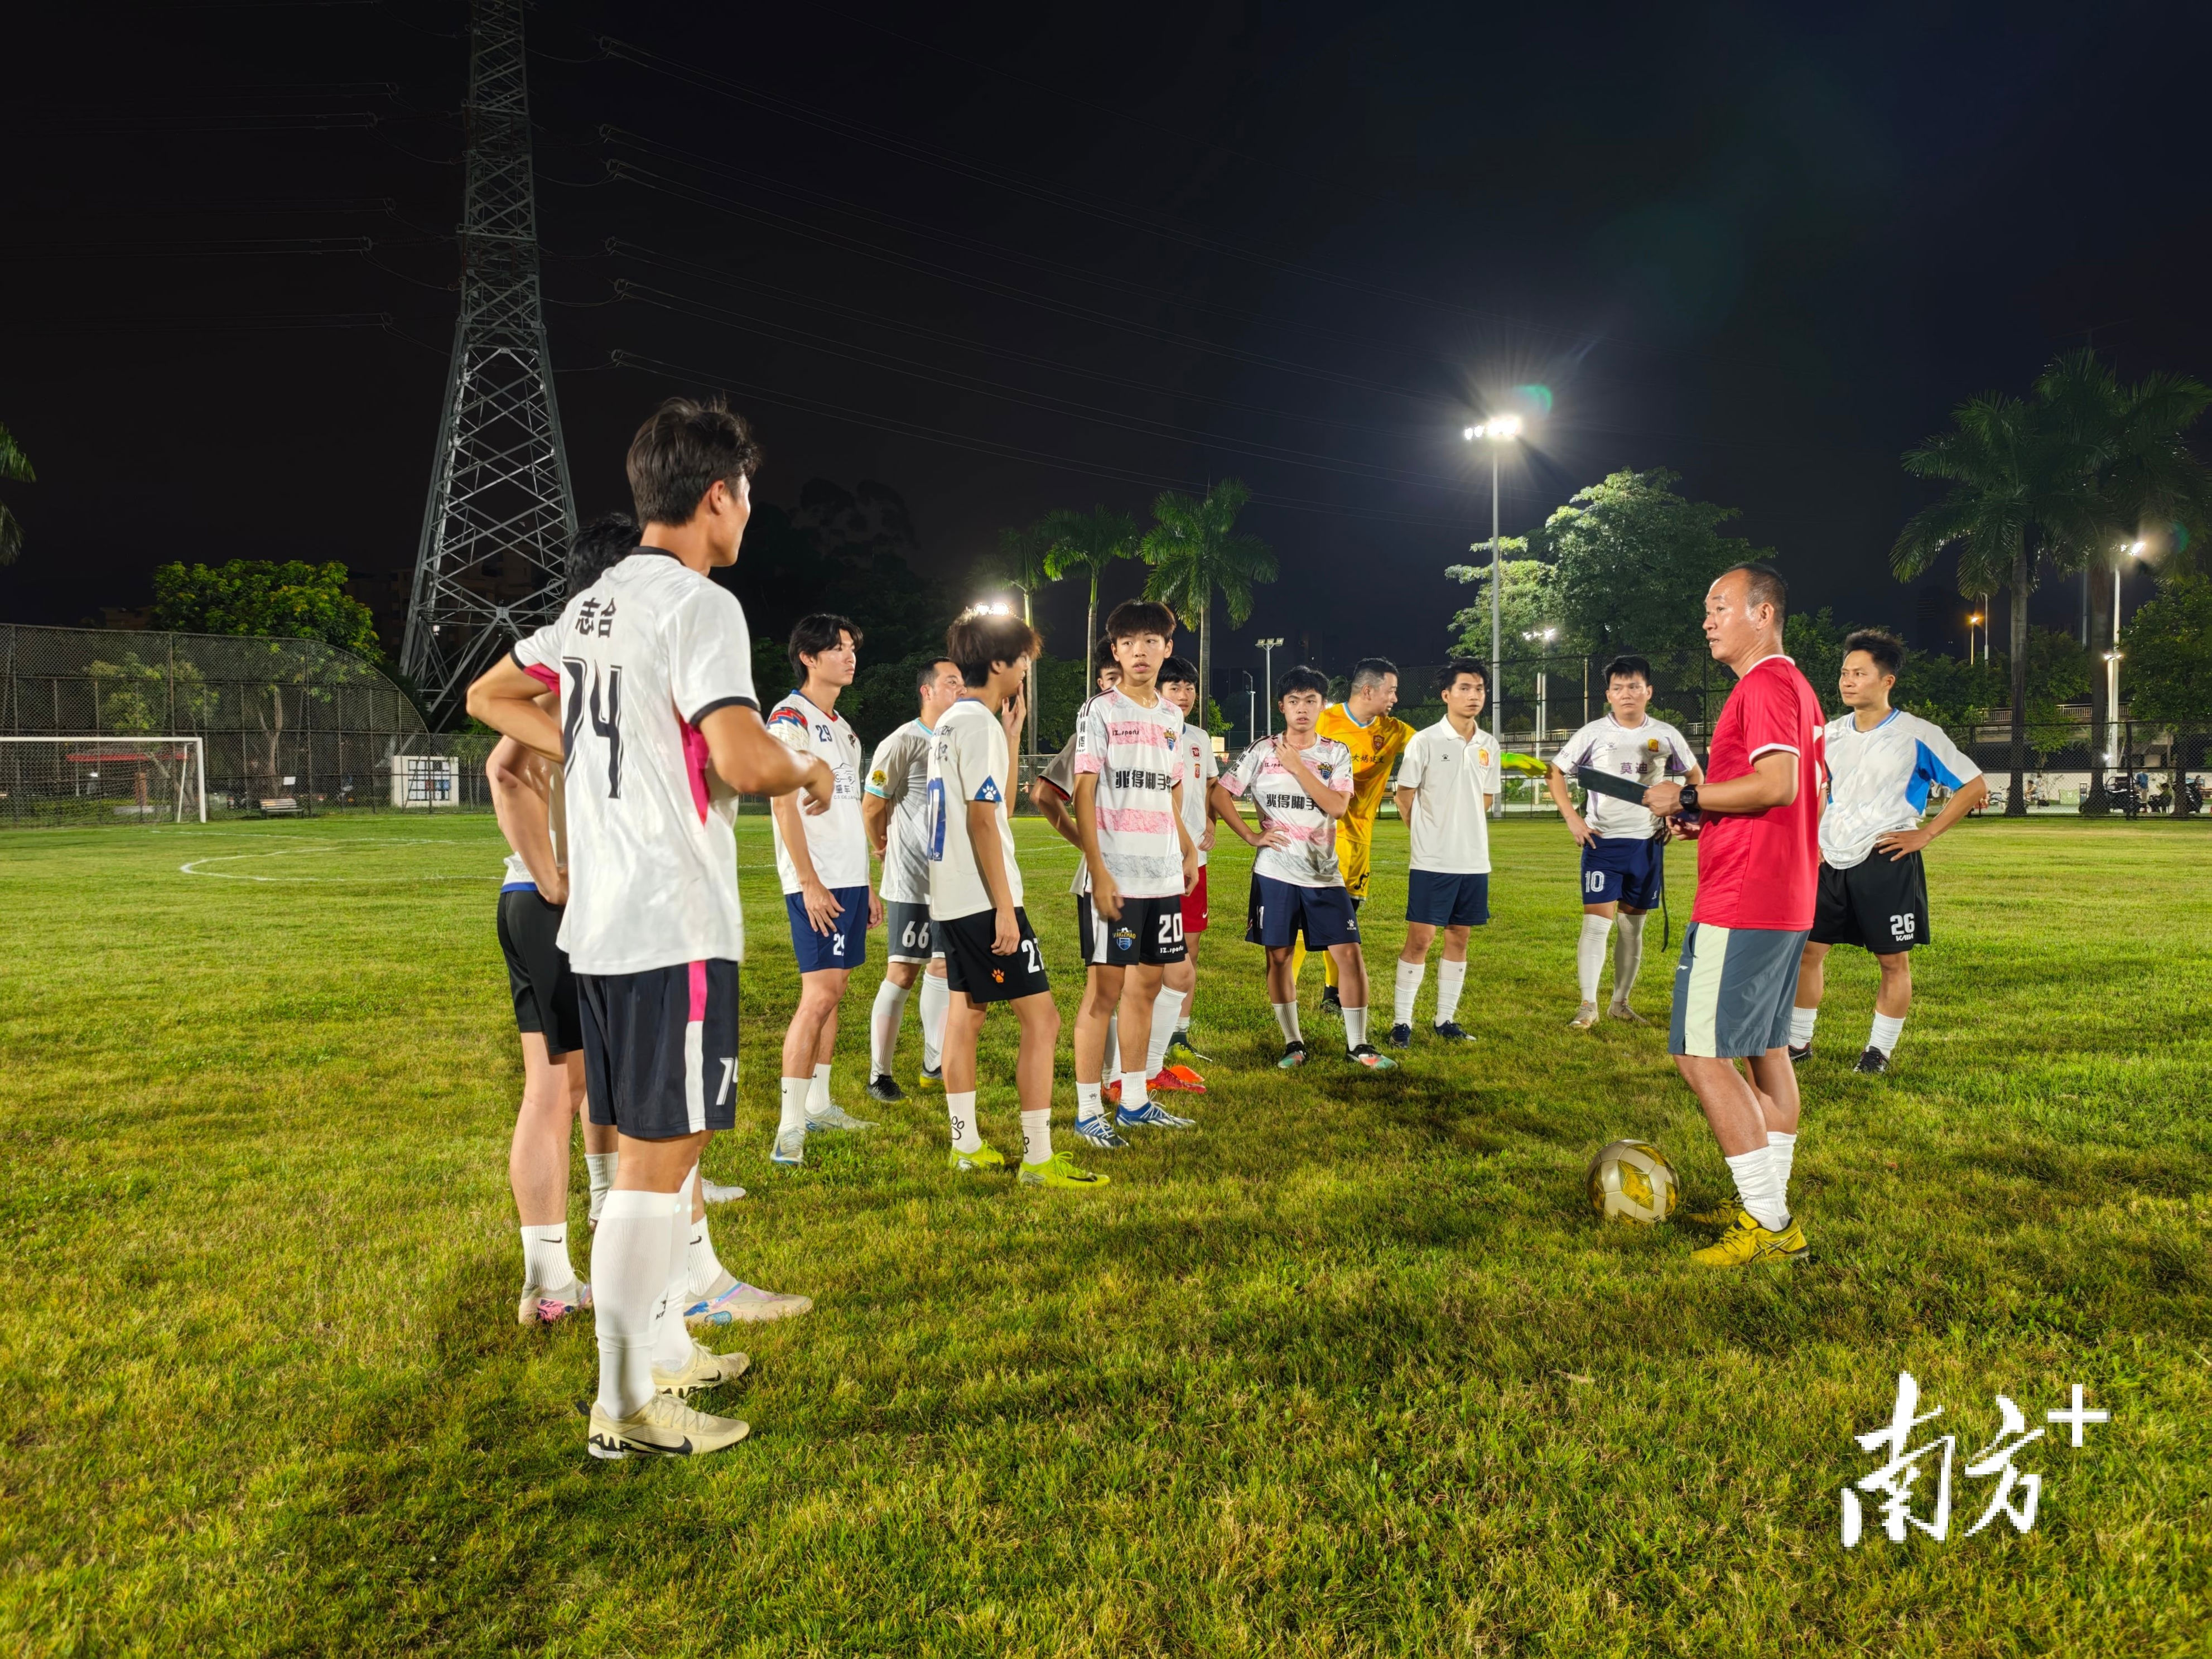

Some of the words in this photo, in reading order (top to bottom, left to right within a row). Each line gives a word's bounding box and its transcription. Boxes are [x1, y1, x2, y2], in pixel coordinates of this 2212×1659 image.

[815, 724, 832, 742] 29
[1620, 762, 1647, 774] 莫迪
[1266, 793, 1319, 812] 兆得脚手
[1585, 871, 1604, 893] 10
[902, 920, 929, 949] 66
[1158, 913, 1183, 944] 20
[1890, 913, 1915, 935] 26
